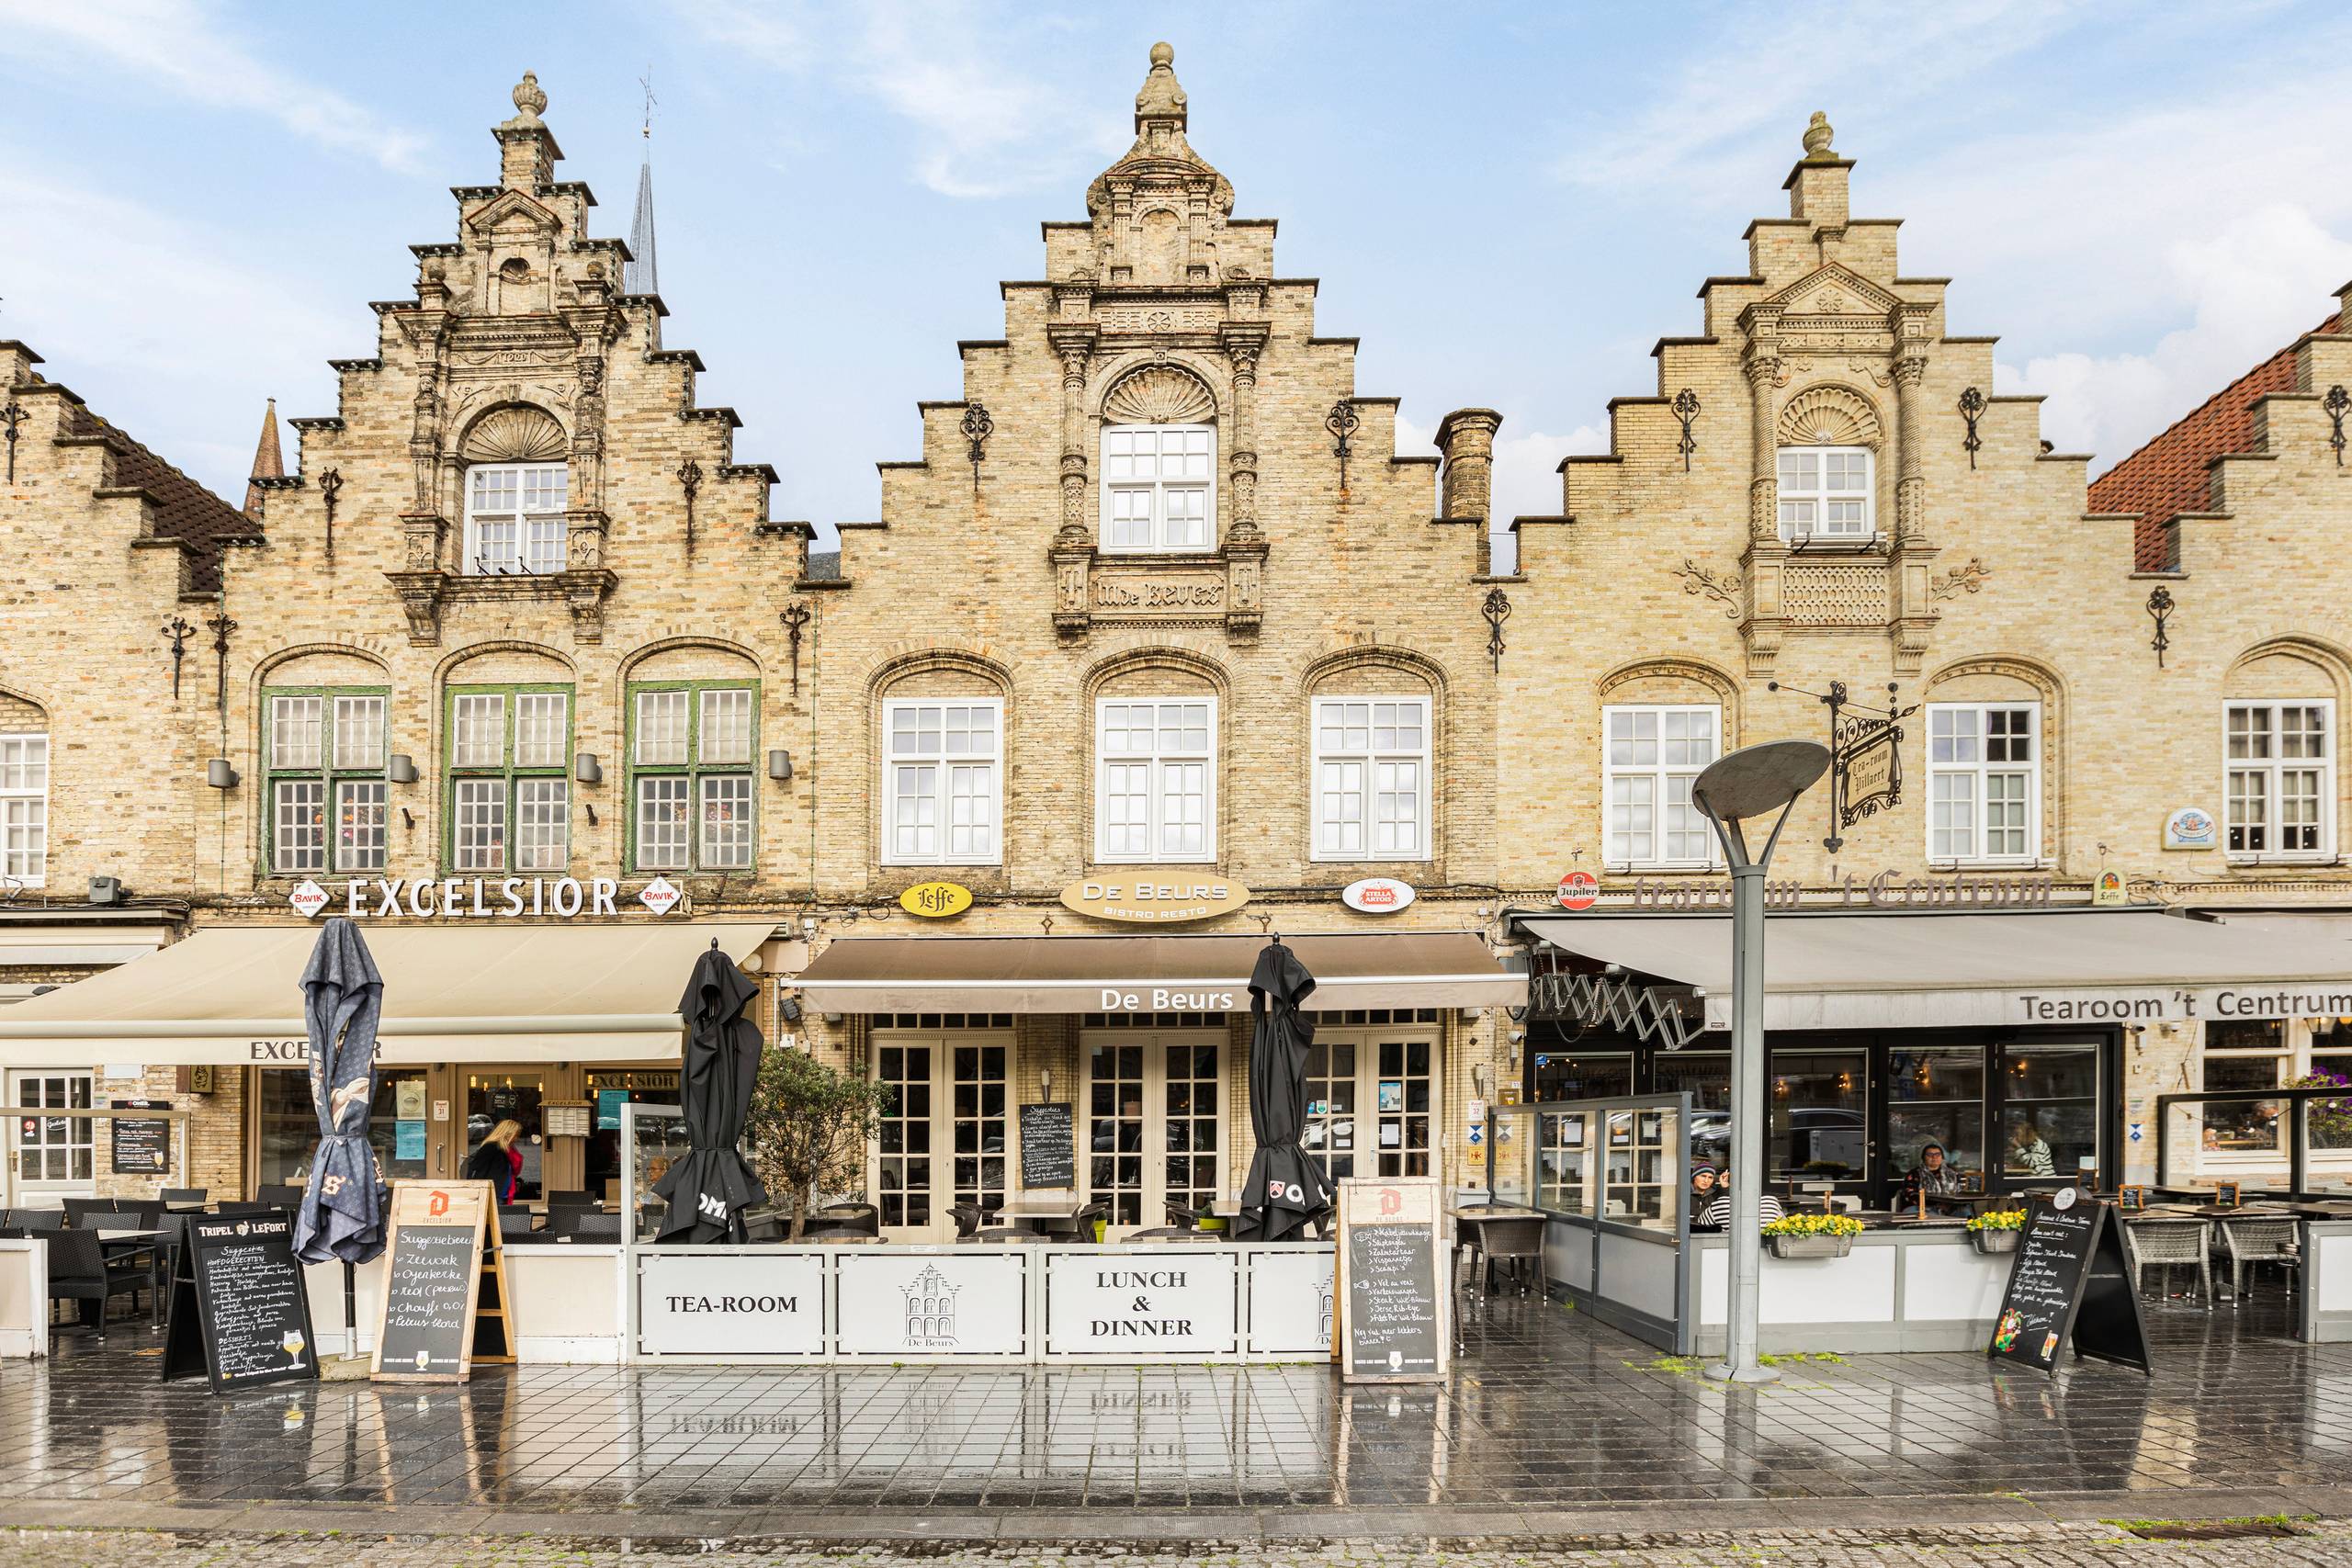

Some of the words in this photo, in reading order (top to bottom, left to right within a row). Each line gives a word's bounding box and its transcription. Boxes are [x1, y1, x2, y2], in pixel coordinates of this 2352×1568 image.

[348, 877, 619, 918] EXCELSIOR
[644, 891, 675, 901] BAVIK
[1560, 886, 1599, 897] Jupiler
[1634, 874, 1803, 909] tearom
[1867, 869, 2052, 908] Centrum
[294, 893, 322, 903] BAVIK
[917, 886, 956, 912] Leffe
[1103, 907, 1155, 919] BISTRO
[1160, 906, 1207, 919] RESTO
[1102, 988, 1140, 1010] De
[1152, 987, 1234, 1010] Beurs
[2019, 995, 2163, 1021] Tearoom
[2216, 988, 2352, 1017] Centrum
[250, 1041, 382, 1060] EXCER
[198, 1226, 234, 1237] TRIPEL
[221, 1246, 265, 1258] Suggesties
[1096, 1271, 1188, 1288] LUNCH
[665, 1296, 798, 1313] TEA-ROOM
[1132, 1295, 1153, 1312] &
[1090, 1319, 1194, 1336] DINNER
[218, 1335, 253, 1345] DESSERTS
[908, 1338, 922, 1347] De
[925, 1338, 955, 1347] Beurs
